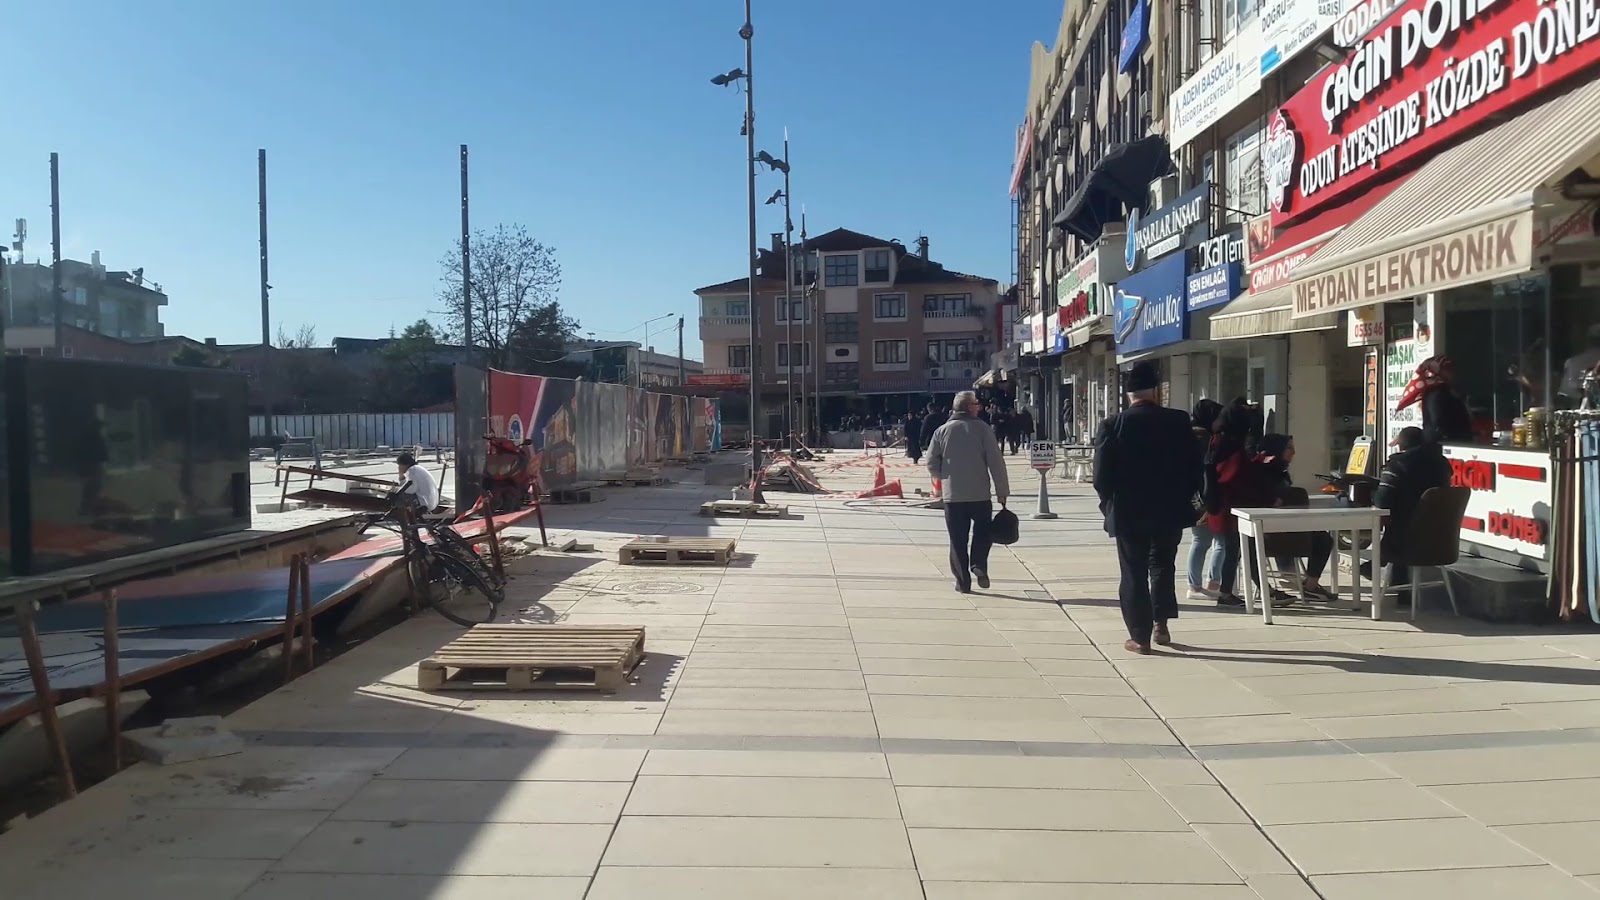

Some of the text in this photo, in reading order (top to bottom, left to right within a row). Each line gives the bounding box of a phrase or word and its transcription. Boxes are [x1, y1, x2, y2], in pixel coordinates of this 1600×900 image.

[1182, 80, 1201, 107] ADEM
[1321, 26, 1392, 135] ÇAĞIN
[1300, 144, 1336, 198] ODUN
[1339, 90, 1420, 177] ATEŞİNDE
[1425, 36, 1505, 128] KÖZDE
[1135, 214, 1171, 254] YAŞARLAR
[1172, 196, 1202, 234] İNŞAAT
[1189, 278, 1201, 294] ŞEN
[1201, 268, 1226, 290] EMLAĞA
[1296, 267, 1359, 313] MEYDAN
[1388, 344, 1415, 370] BAŞAK
[1033, 443, 1054, 452] ŞEN
[1488, 508, 1541, 544] DÖNER
